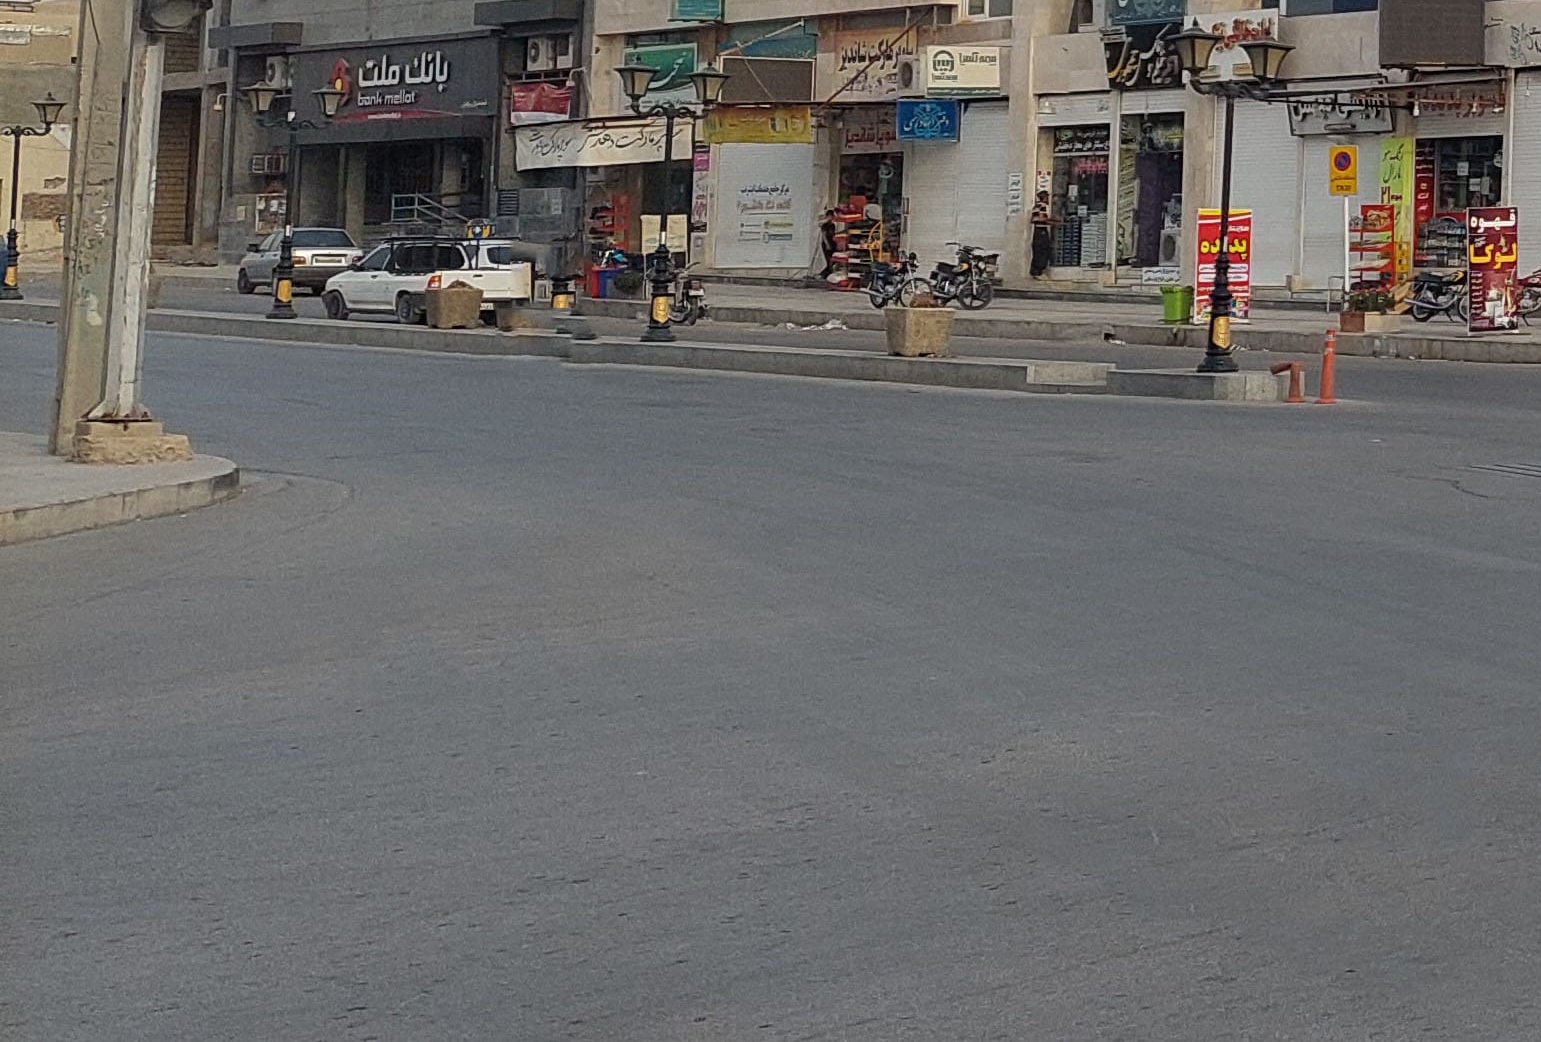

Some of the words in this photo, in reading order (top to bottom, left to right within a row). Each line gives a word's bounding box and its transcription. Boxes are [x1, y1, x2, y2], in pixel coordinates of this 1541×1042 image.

[358, 54, 401, 88] ملت
[358, 92, 382, 106] bank
[384, 89, 416, 105] mellat
[1470, 208, 1517, 234] قهوه
[1200, 238, 1247, 260] پدده
[1469, 241, 1517, 270] لوکا
